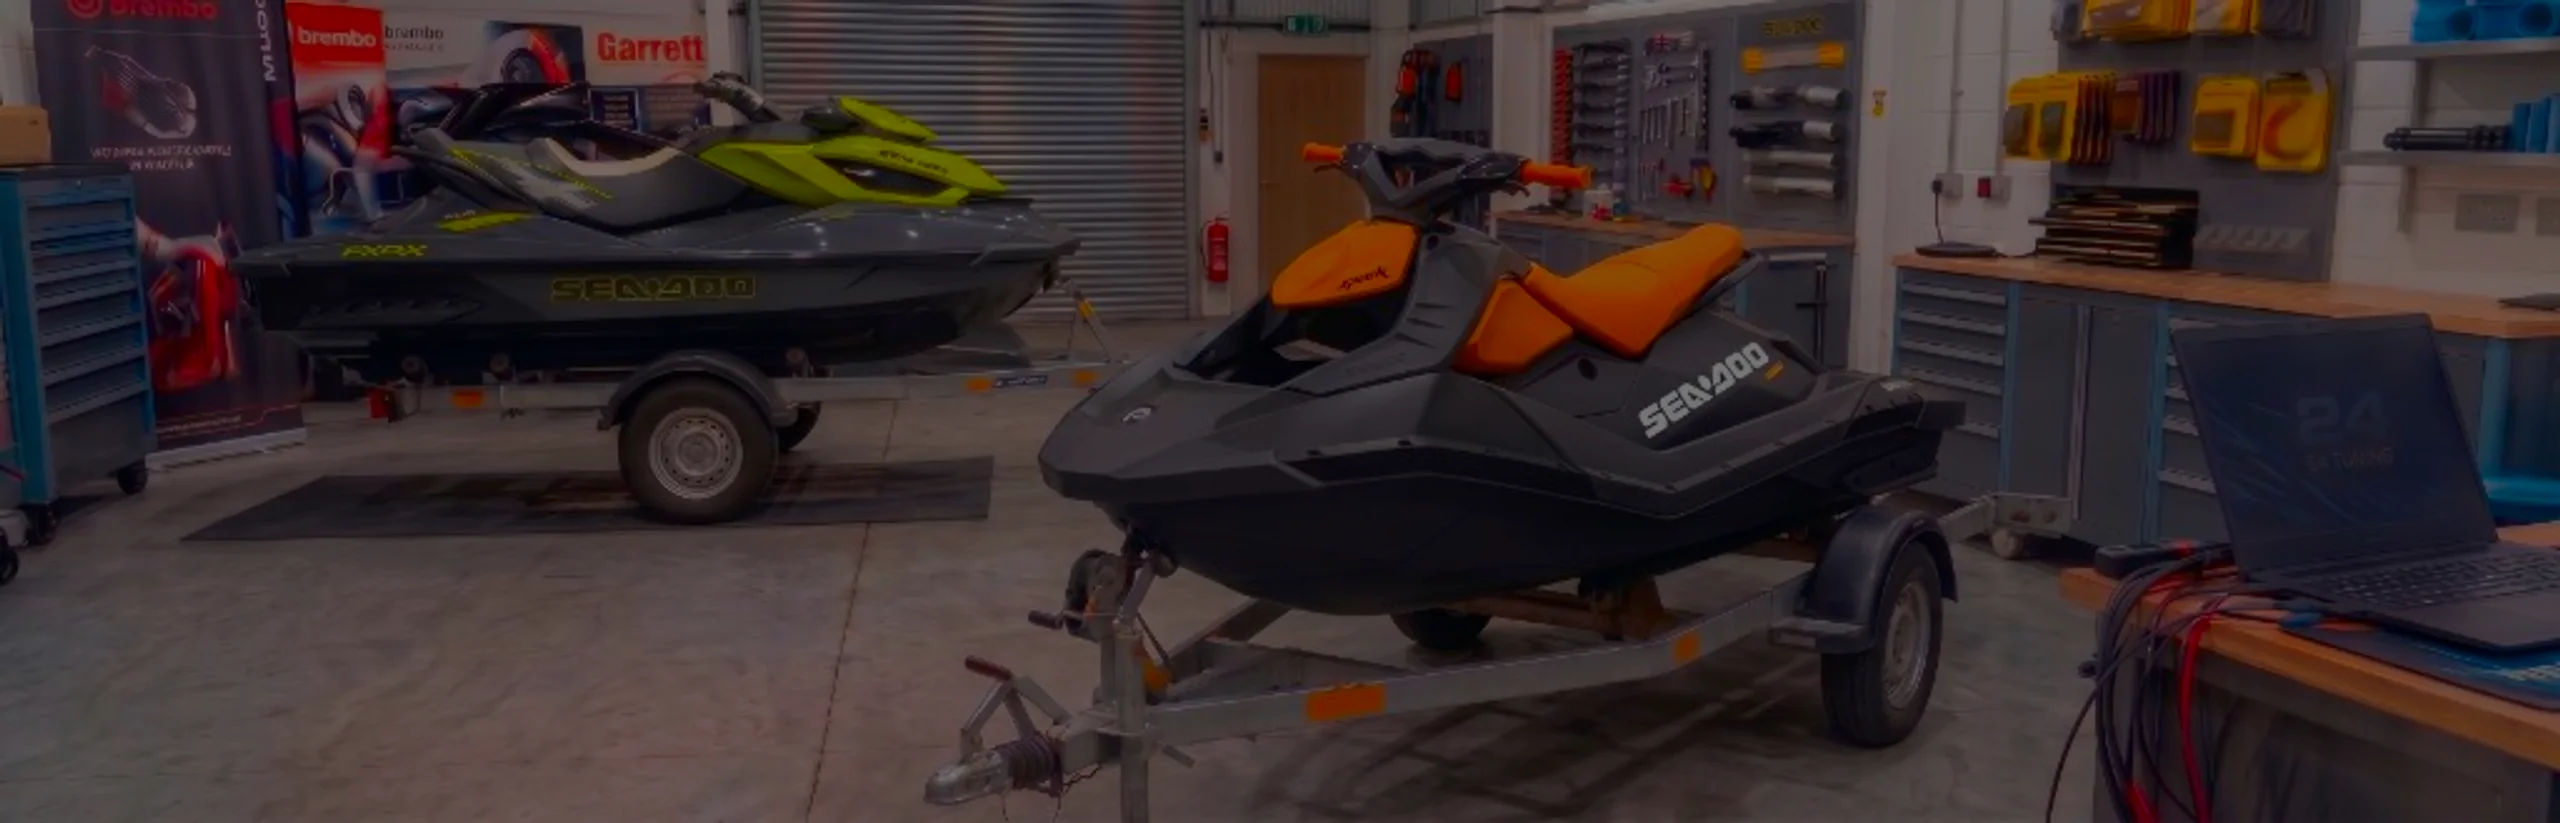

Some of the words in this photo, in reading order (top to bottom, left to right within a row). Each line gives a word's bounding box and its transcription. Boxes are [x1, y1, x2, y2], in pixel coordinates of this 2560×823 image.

[297, 25, 377, 47] brembo
[384, 25, 444, 39] brembo
[597, 32, 704, 62] Garrett
